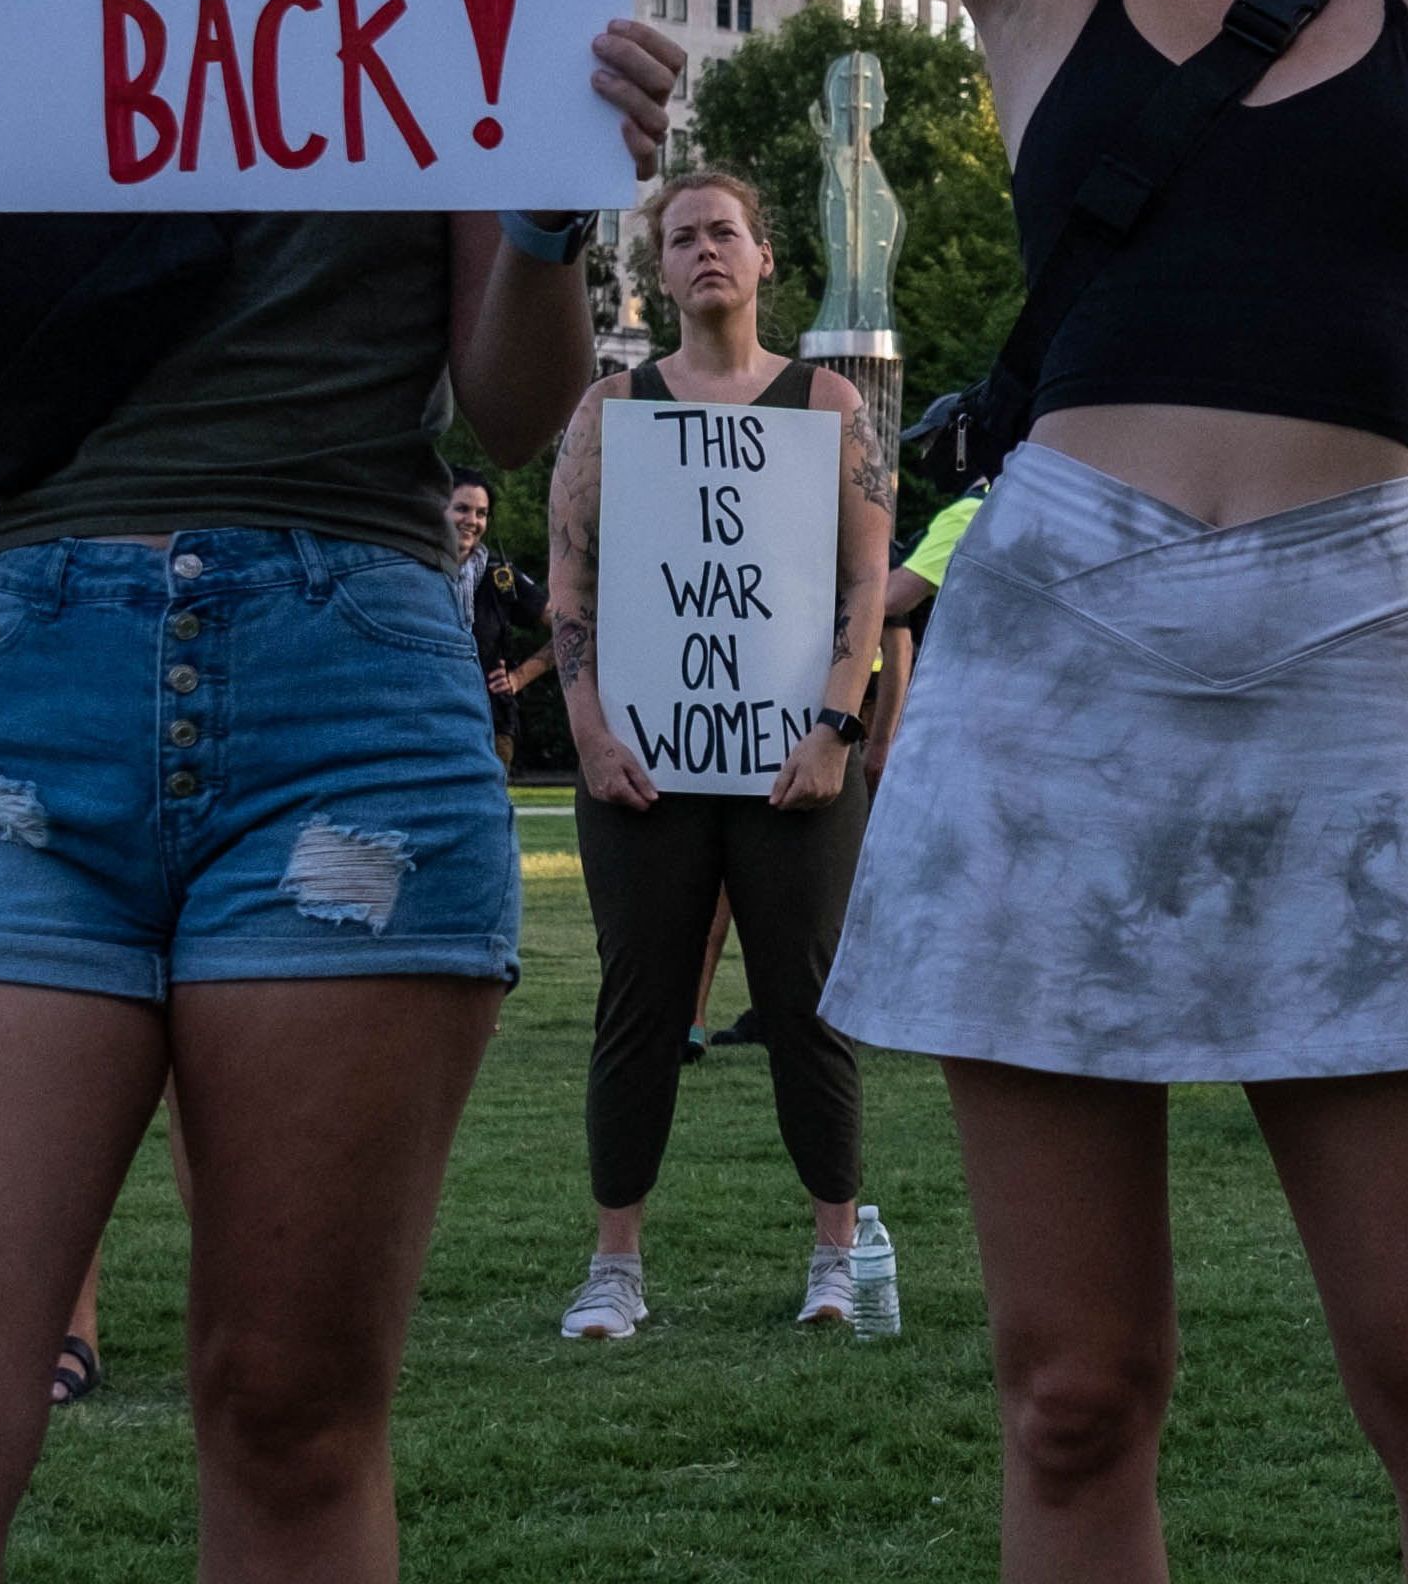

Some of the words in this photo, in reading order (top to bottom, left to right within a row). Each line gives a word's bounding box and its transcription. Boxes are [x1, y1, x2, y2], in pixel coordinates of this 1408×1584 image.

[653, 409, 767, 473] THIS
[699, 485, 745, 547] IS
[660, 560, 773, 620] WAR
[681, 632, 741, 692] ON
[626, 699, 813, 776] WOMEN
